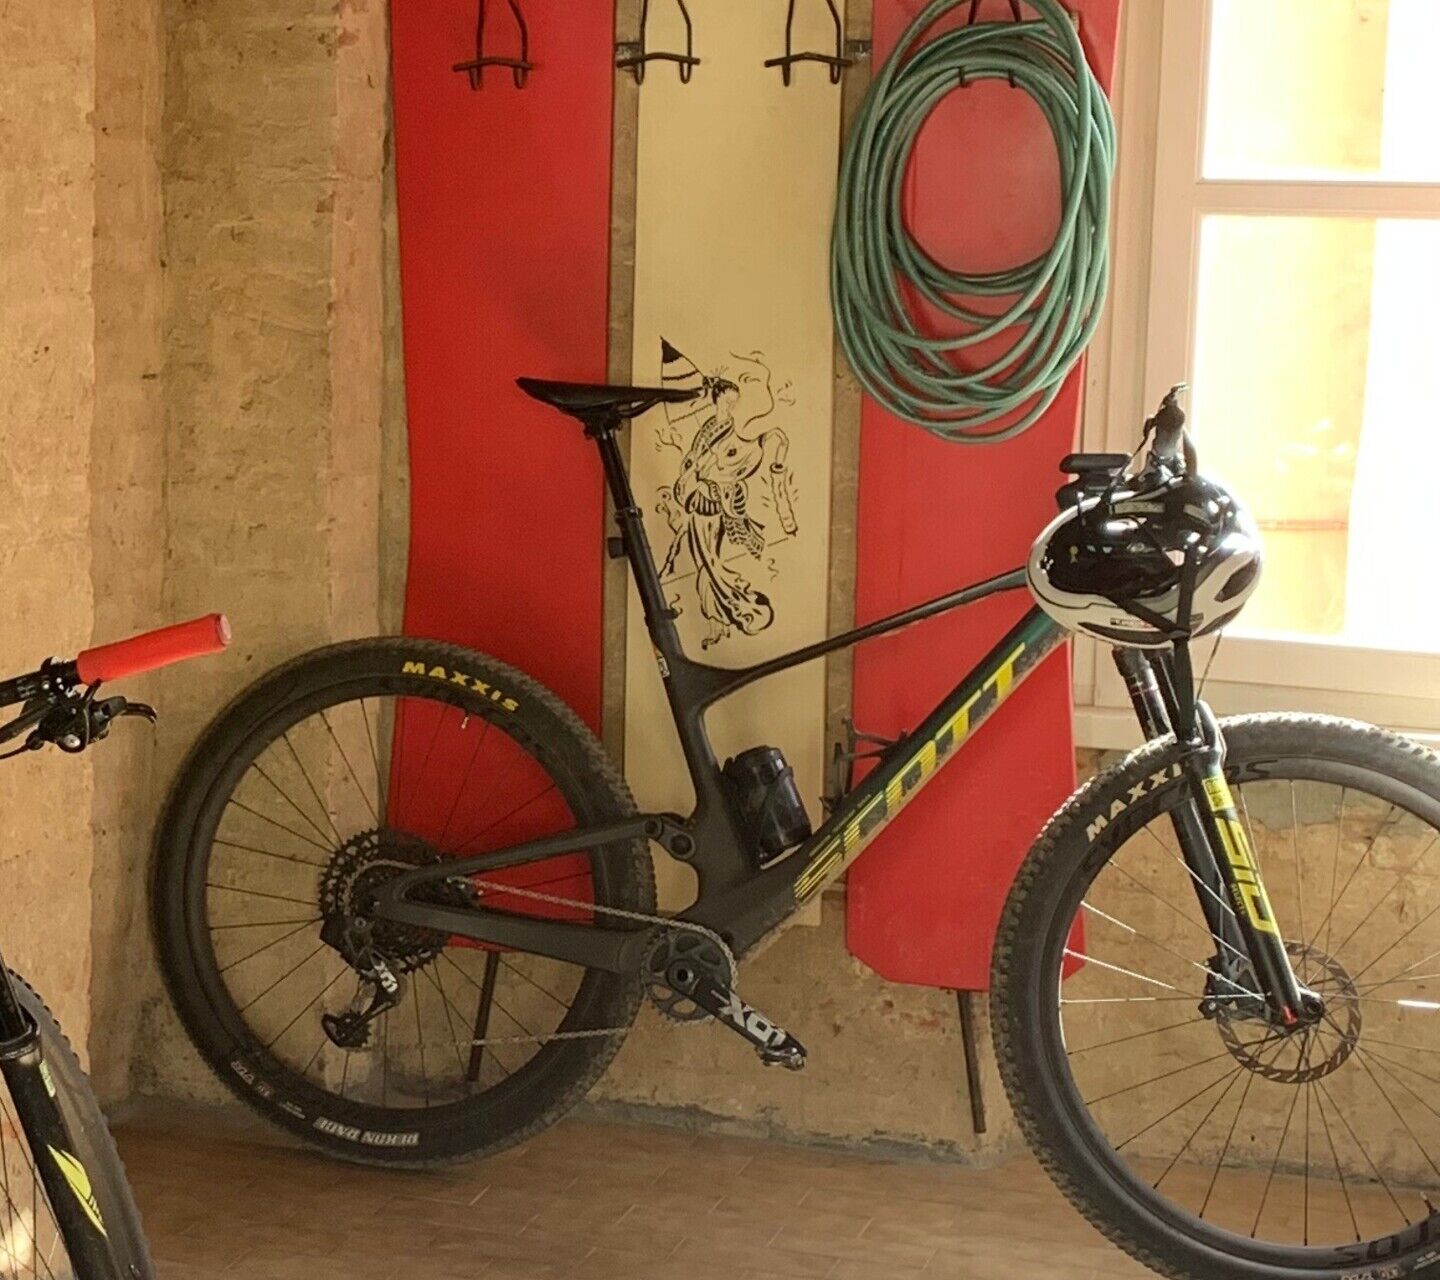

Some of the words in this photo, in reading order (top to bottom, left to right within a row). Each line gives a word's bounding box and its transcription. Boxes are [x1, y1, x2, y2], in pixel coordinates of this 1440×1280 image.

[402, 661, 519, 711] MAXXIS
[793, 642, 1026, 904] SCOTT
[1086, 762, 1183, 842] MAXXI
